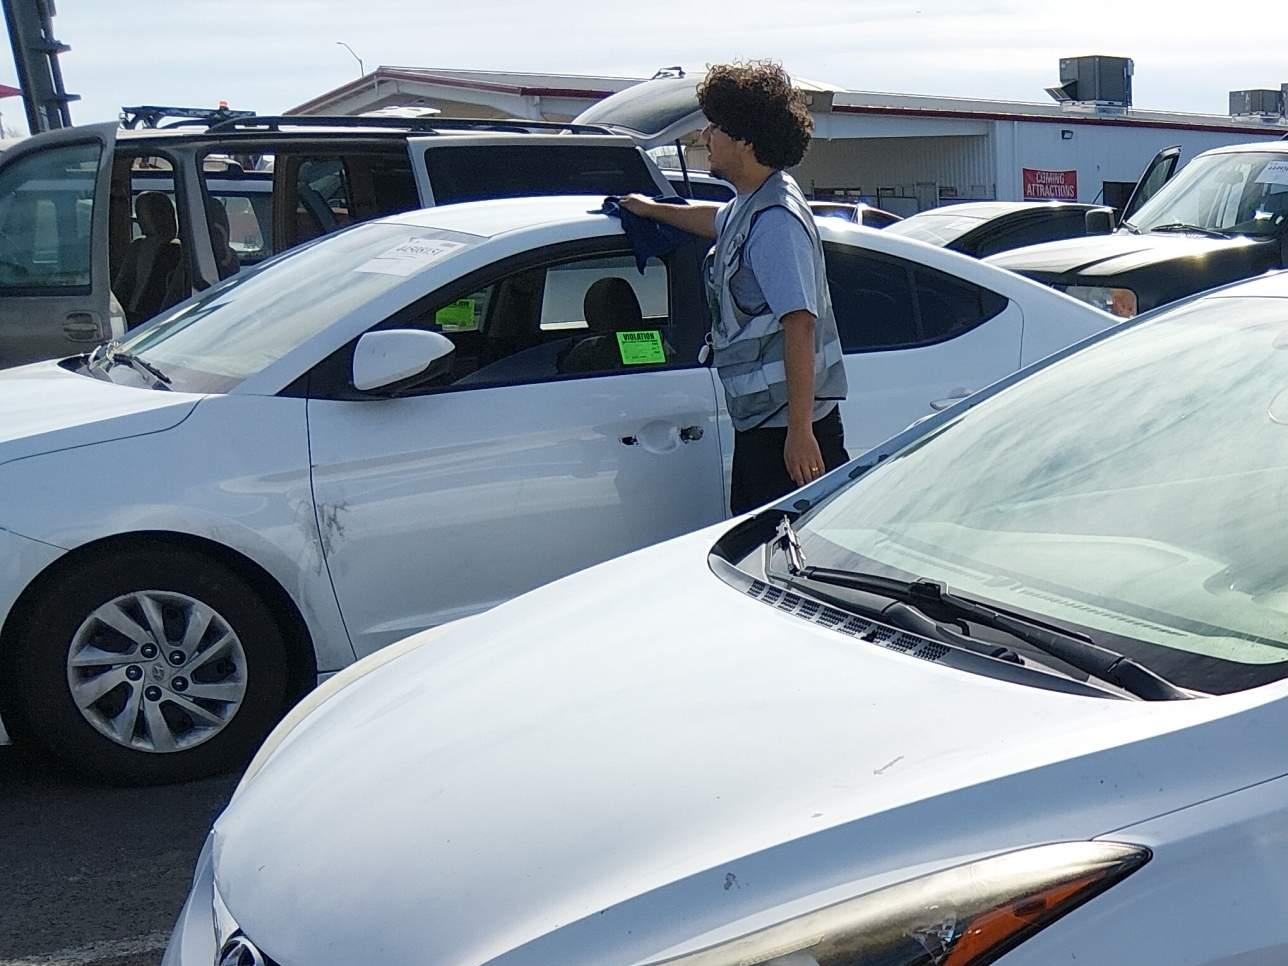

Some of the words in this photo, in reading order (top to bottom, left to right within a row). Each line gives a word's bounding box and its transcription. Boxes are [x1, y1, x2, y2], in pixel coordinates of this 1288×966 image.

[1035, 171, 1065, 184] COMING
[1026, 183, 1075, 198] ATTRACTIONS
[622, 332, 655, 341] VIOLATION
